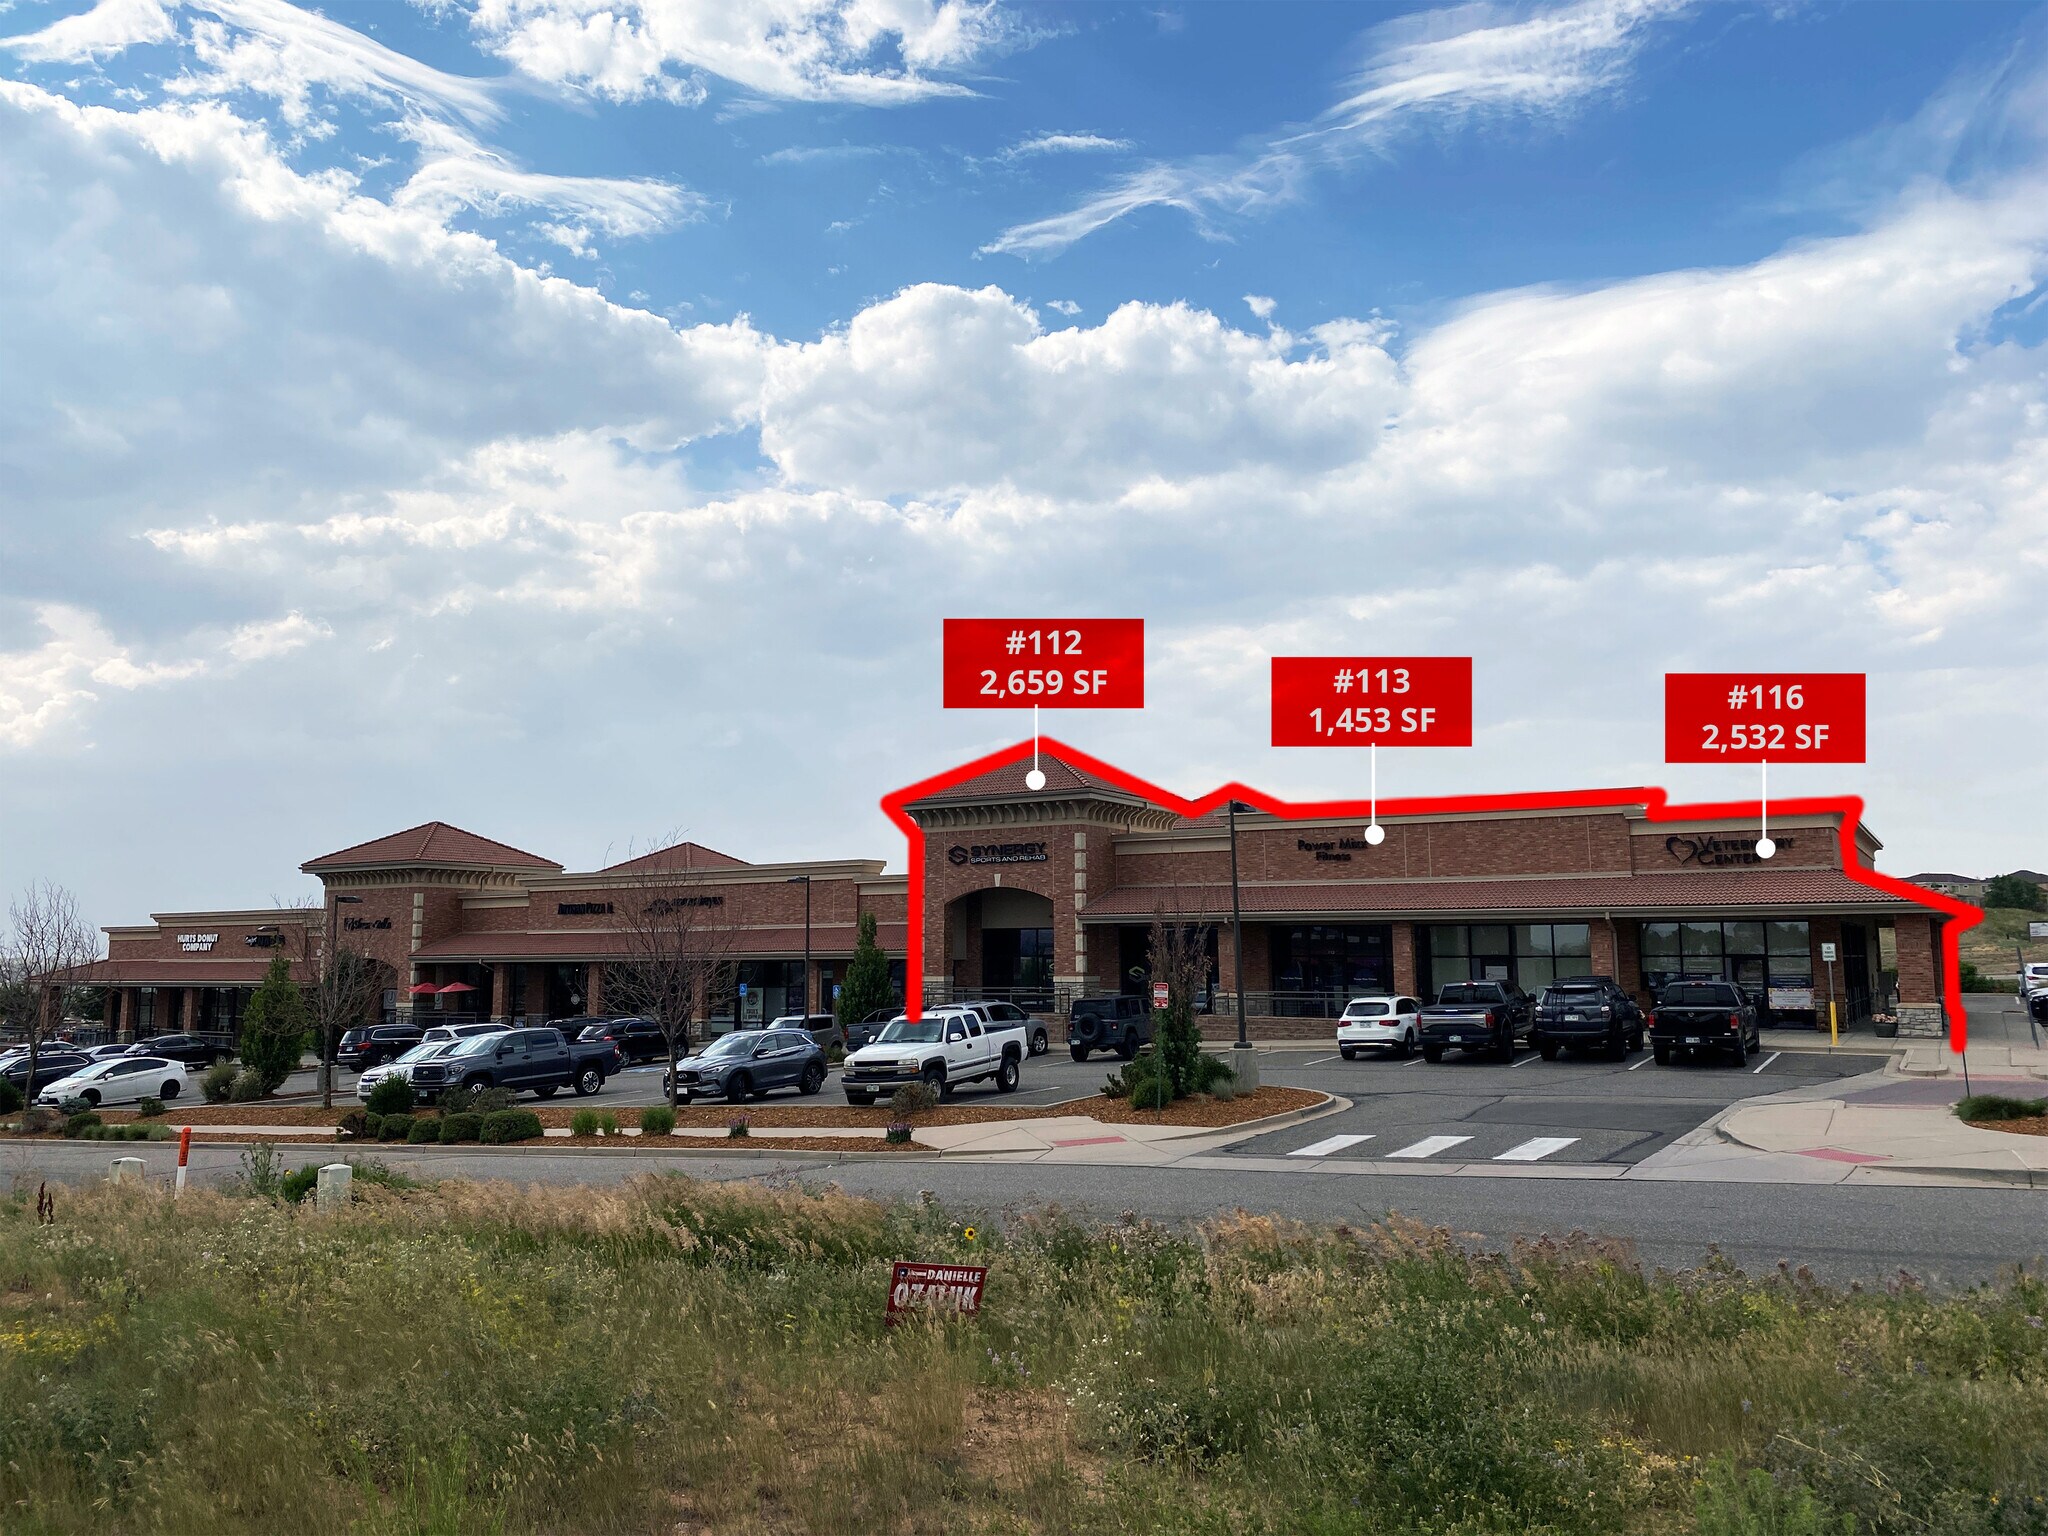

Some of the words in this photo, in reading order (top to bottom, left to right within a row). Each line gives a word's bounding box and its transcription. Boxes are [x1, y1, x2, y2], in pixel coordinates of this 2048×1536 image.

[970, 842, 1046, 856] SYNERGY
[1297, 839, 1336, 851] Power
[1697, 836, 1794, 851] VETERIRY
[970, 856, 1001, 864] SPORTS
[177, 935, 197, 943] HURTS
[197, 934, 219, 942] DONUT
[182, 943, 213, 952] COMPANY
[927, 1269, 982, 1283] DANIELLE
